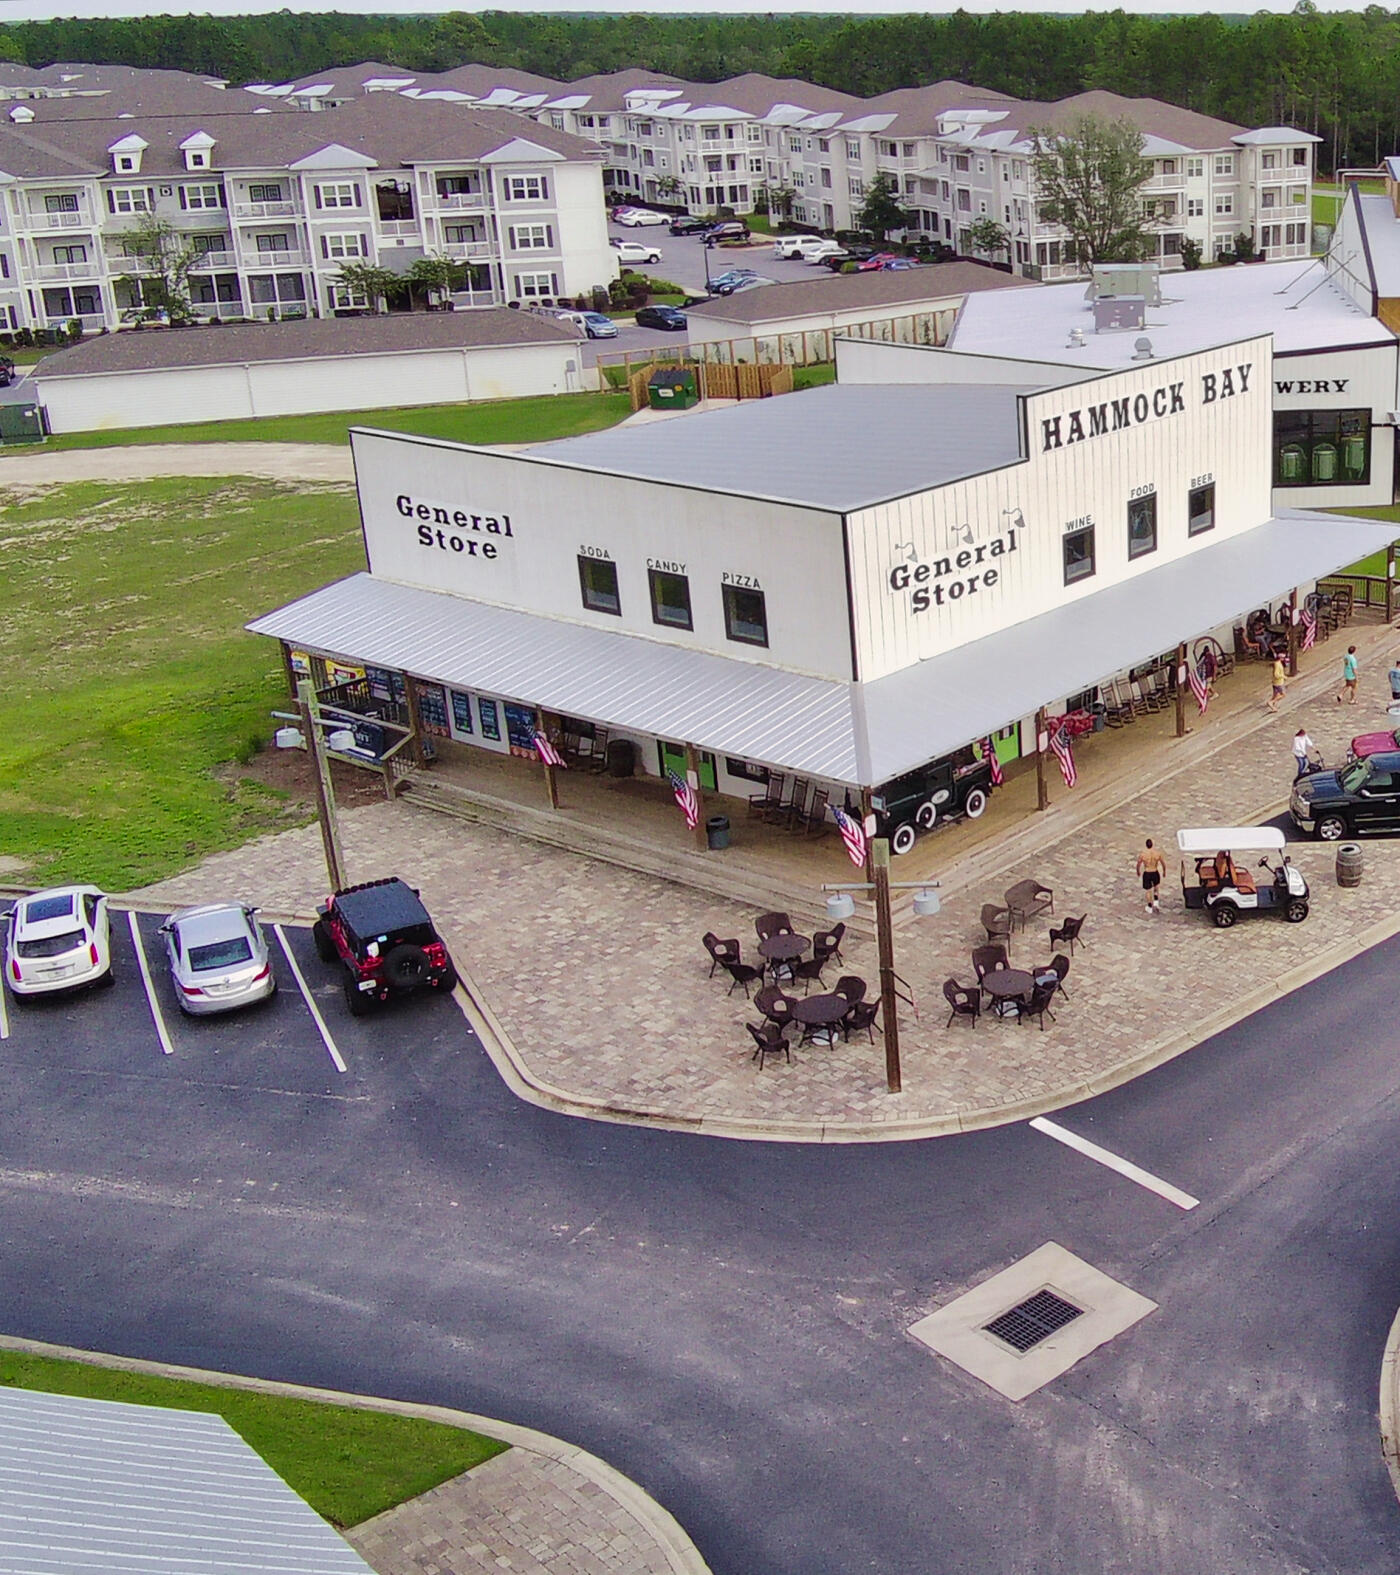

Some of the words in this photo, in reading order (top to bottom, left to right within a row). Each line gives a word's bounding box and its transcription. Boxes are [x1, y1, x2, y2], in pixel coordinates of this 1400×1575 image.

[1274, 379, 1350, 394] WERY
[1042, 382, 1185, 451] HAMMOCK
[1202, 363, 1252, 404] BAY
[1191, 472, 1213, 488] BEER
[1130, 483, 1155, 499] FOOD
[395, 494, 514, 538] General
[1065, 514, 1092, 532] WINE
[417, 524, 498, 559] Store
[579, 544, 611, 560] SODA
[889, 528, 1017, 591] General
[646, 558, 687, 575] CANDY
[722, 571, 761, 589] PIZZA
[912, 568, 998, 615] Store
